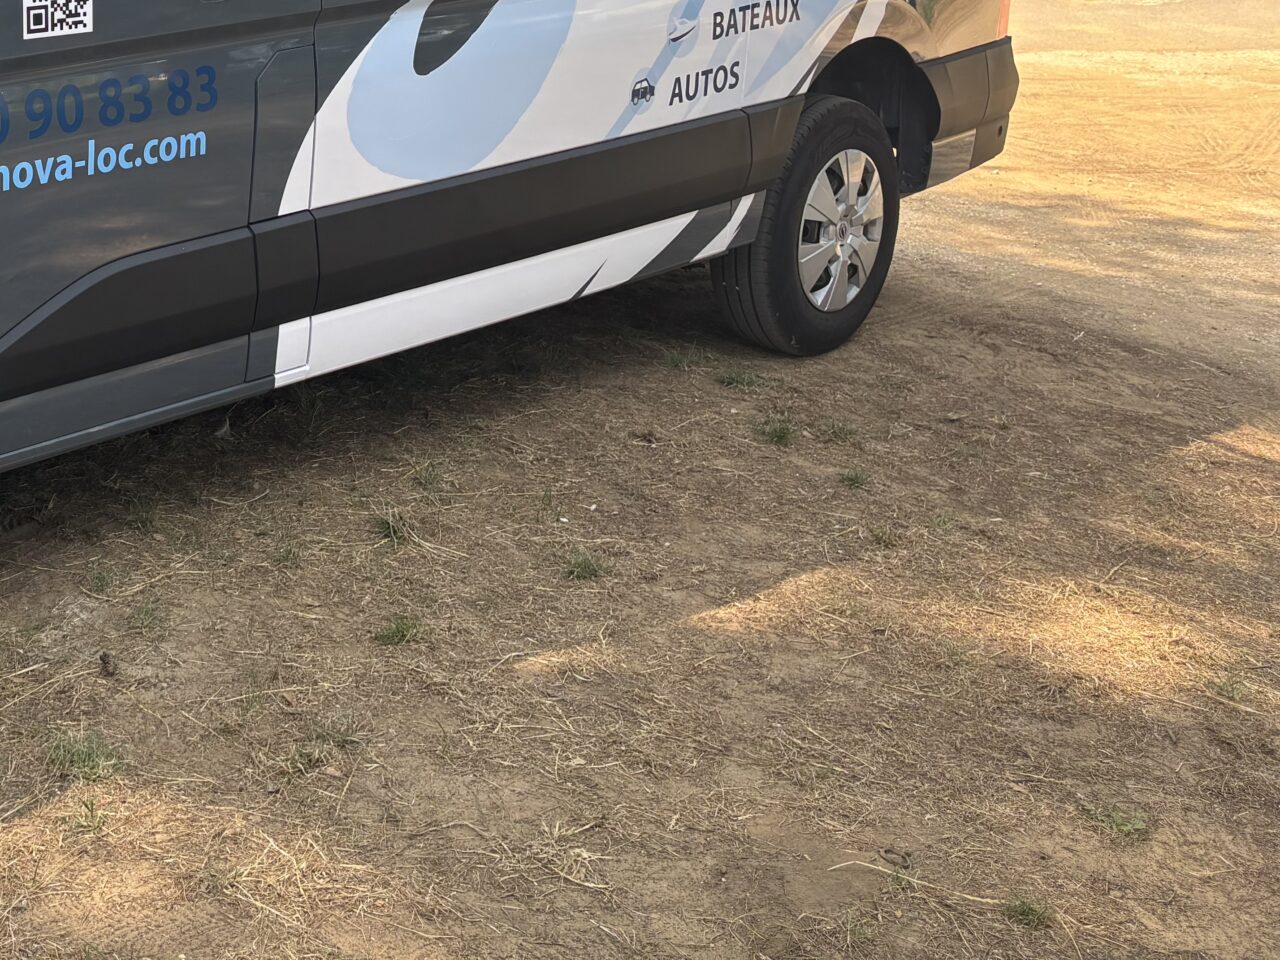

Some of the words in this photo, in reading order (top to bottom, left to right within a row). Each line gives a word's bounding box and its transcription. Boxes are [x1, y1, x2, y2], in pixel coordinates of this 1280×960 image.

[25, 84, 84, 139] 90
[98, 74, 153, 127] 83
[167, 65, 219, 116] 83
[669, 61, 740, 106] AUTOS
